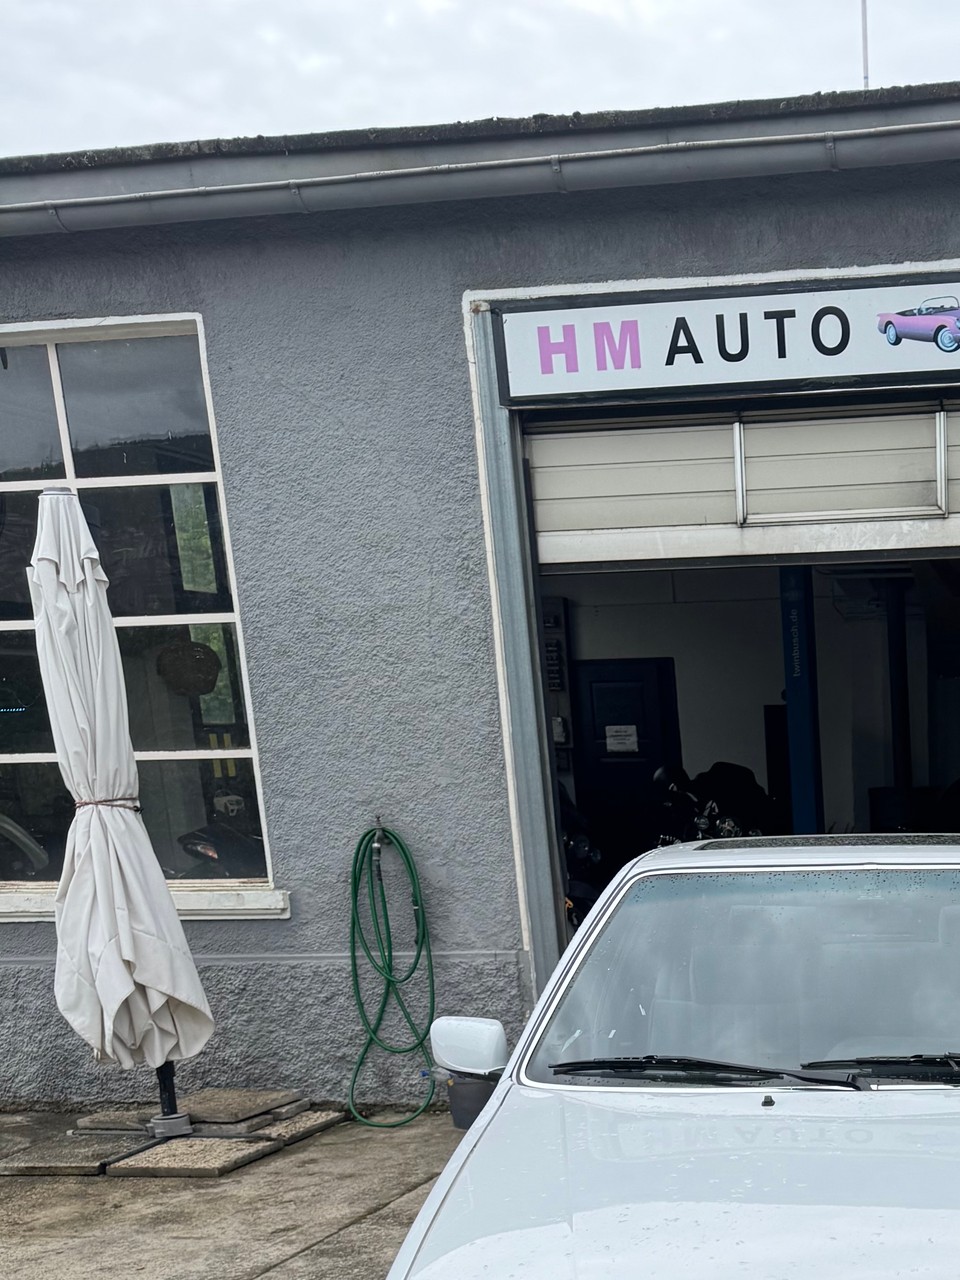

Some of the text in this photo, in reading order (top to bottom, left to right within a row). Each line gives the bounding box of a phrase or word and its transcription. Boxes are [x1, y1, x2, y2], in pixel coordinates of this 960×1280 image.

[537, 305, 851, 375] HM AUTO
[789, 608, 801, 677] twinbusch.de
